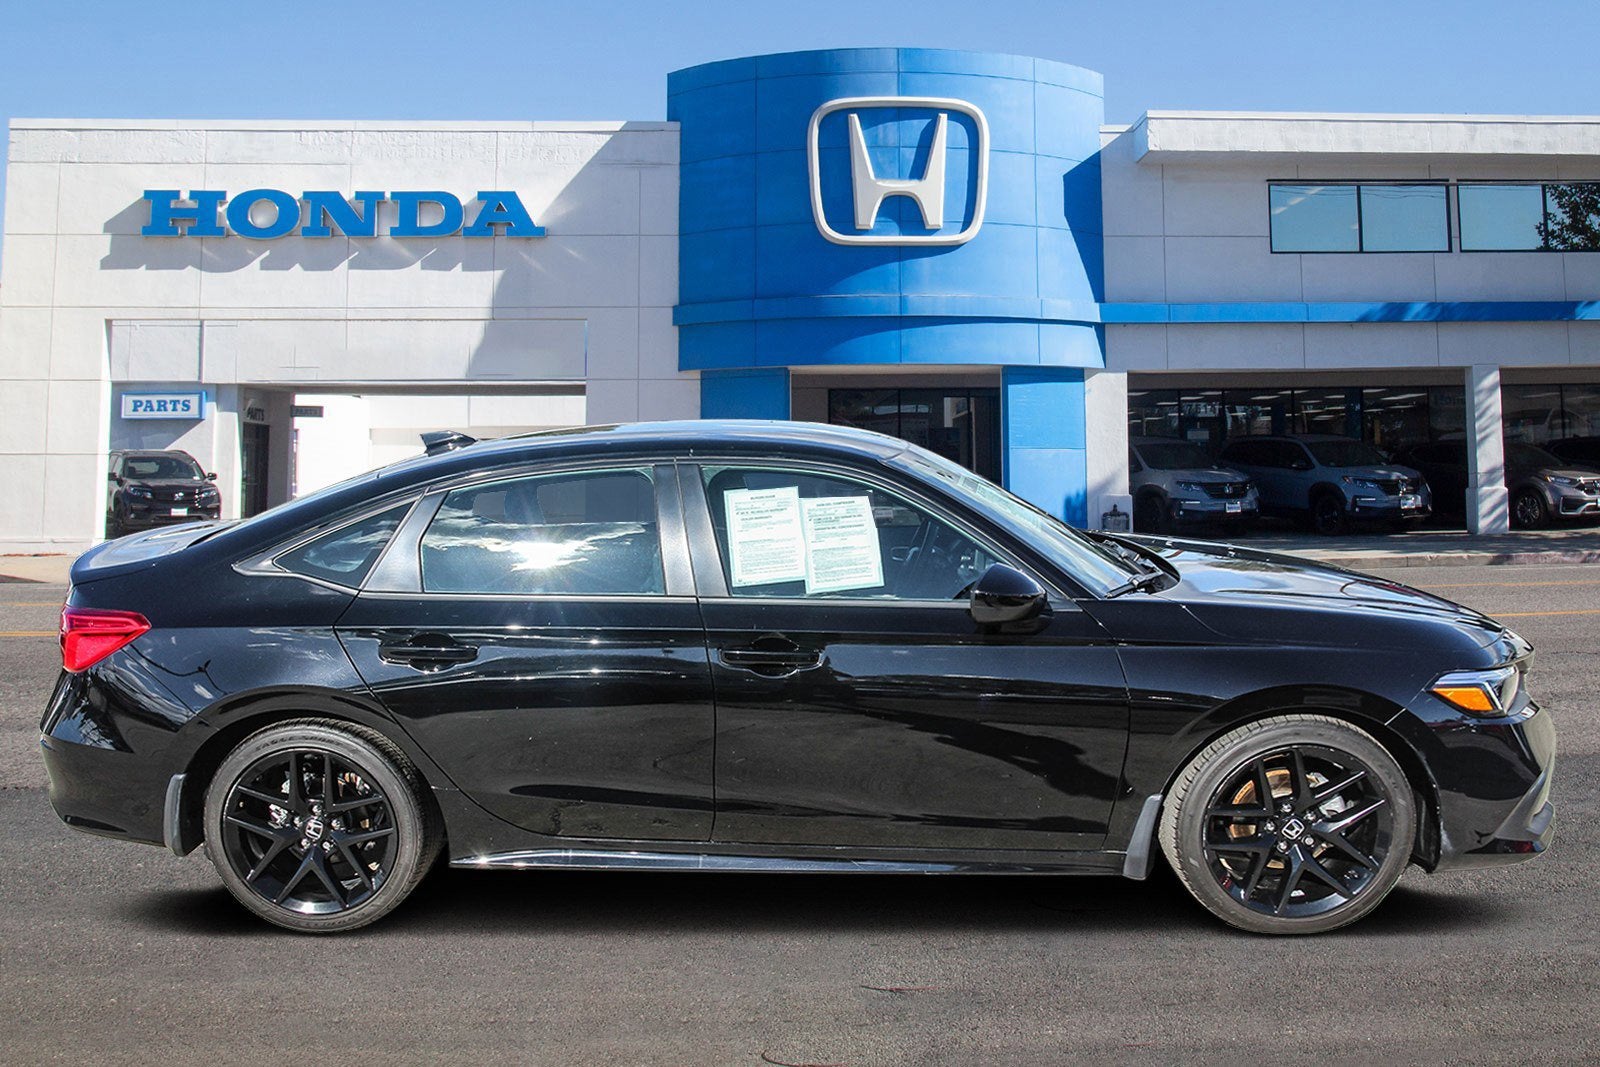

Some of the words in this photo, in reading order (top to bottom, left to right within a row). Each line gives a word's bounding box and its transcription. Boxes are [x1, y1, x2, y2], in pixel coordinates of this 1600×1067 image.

[848, 113, 948, 229] H
[141, 189, 548, 240] HONDA
[131, 399, 192, 412] PARTS
